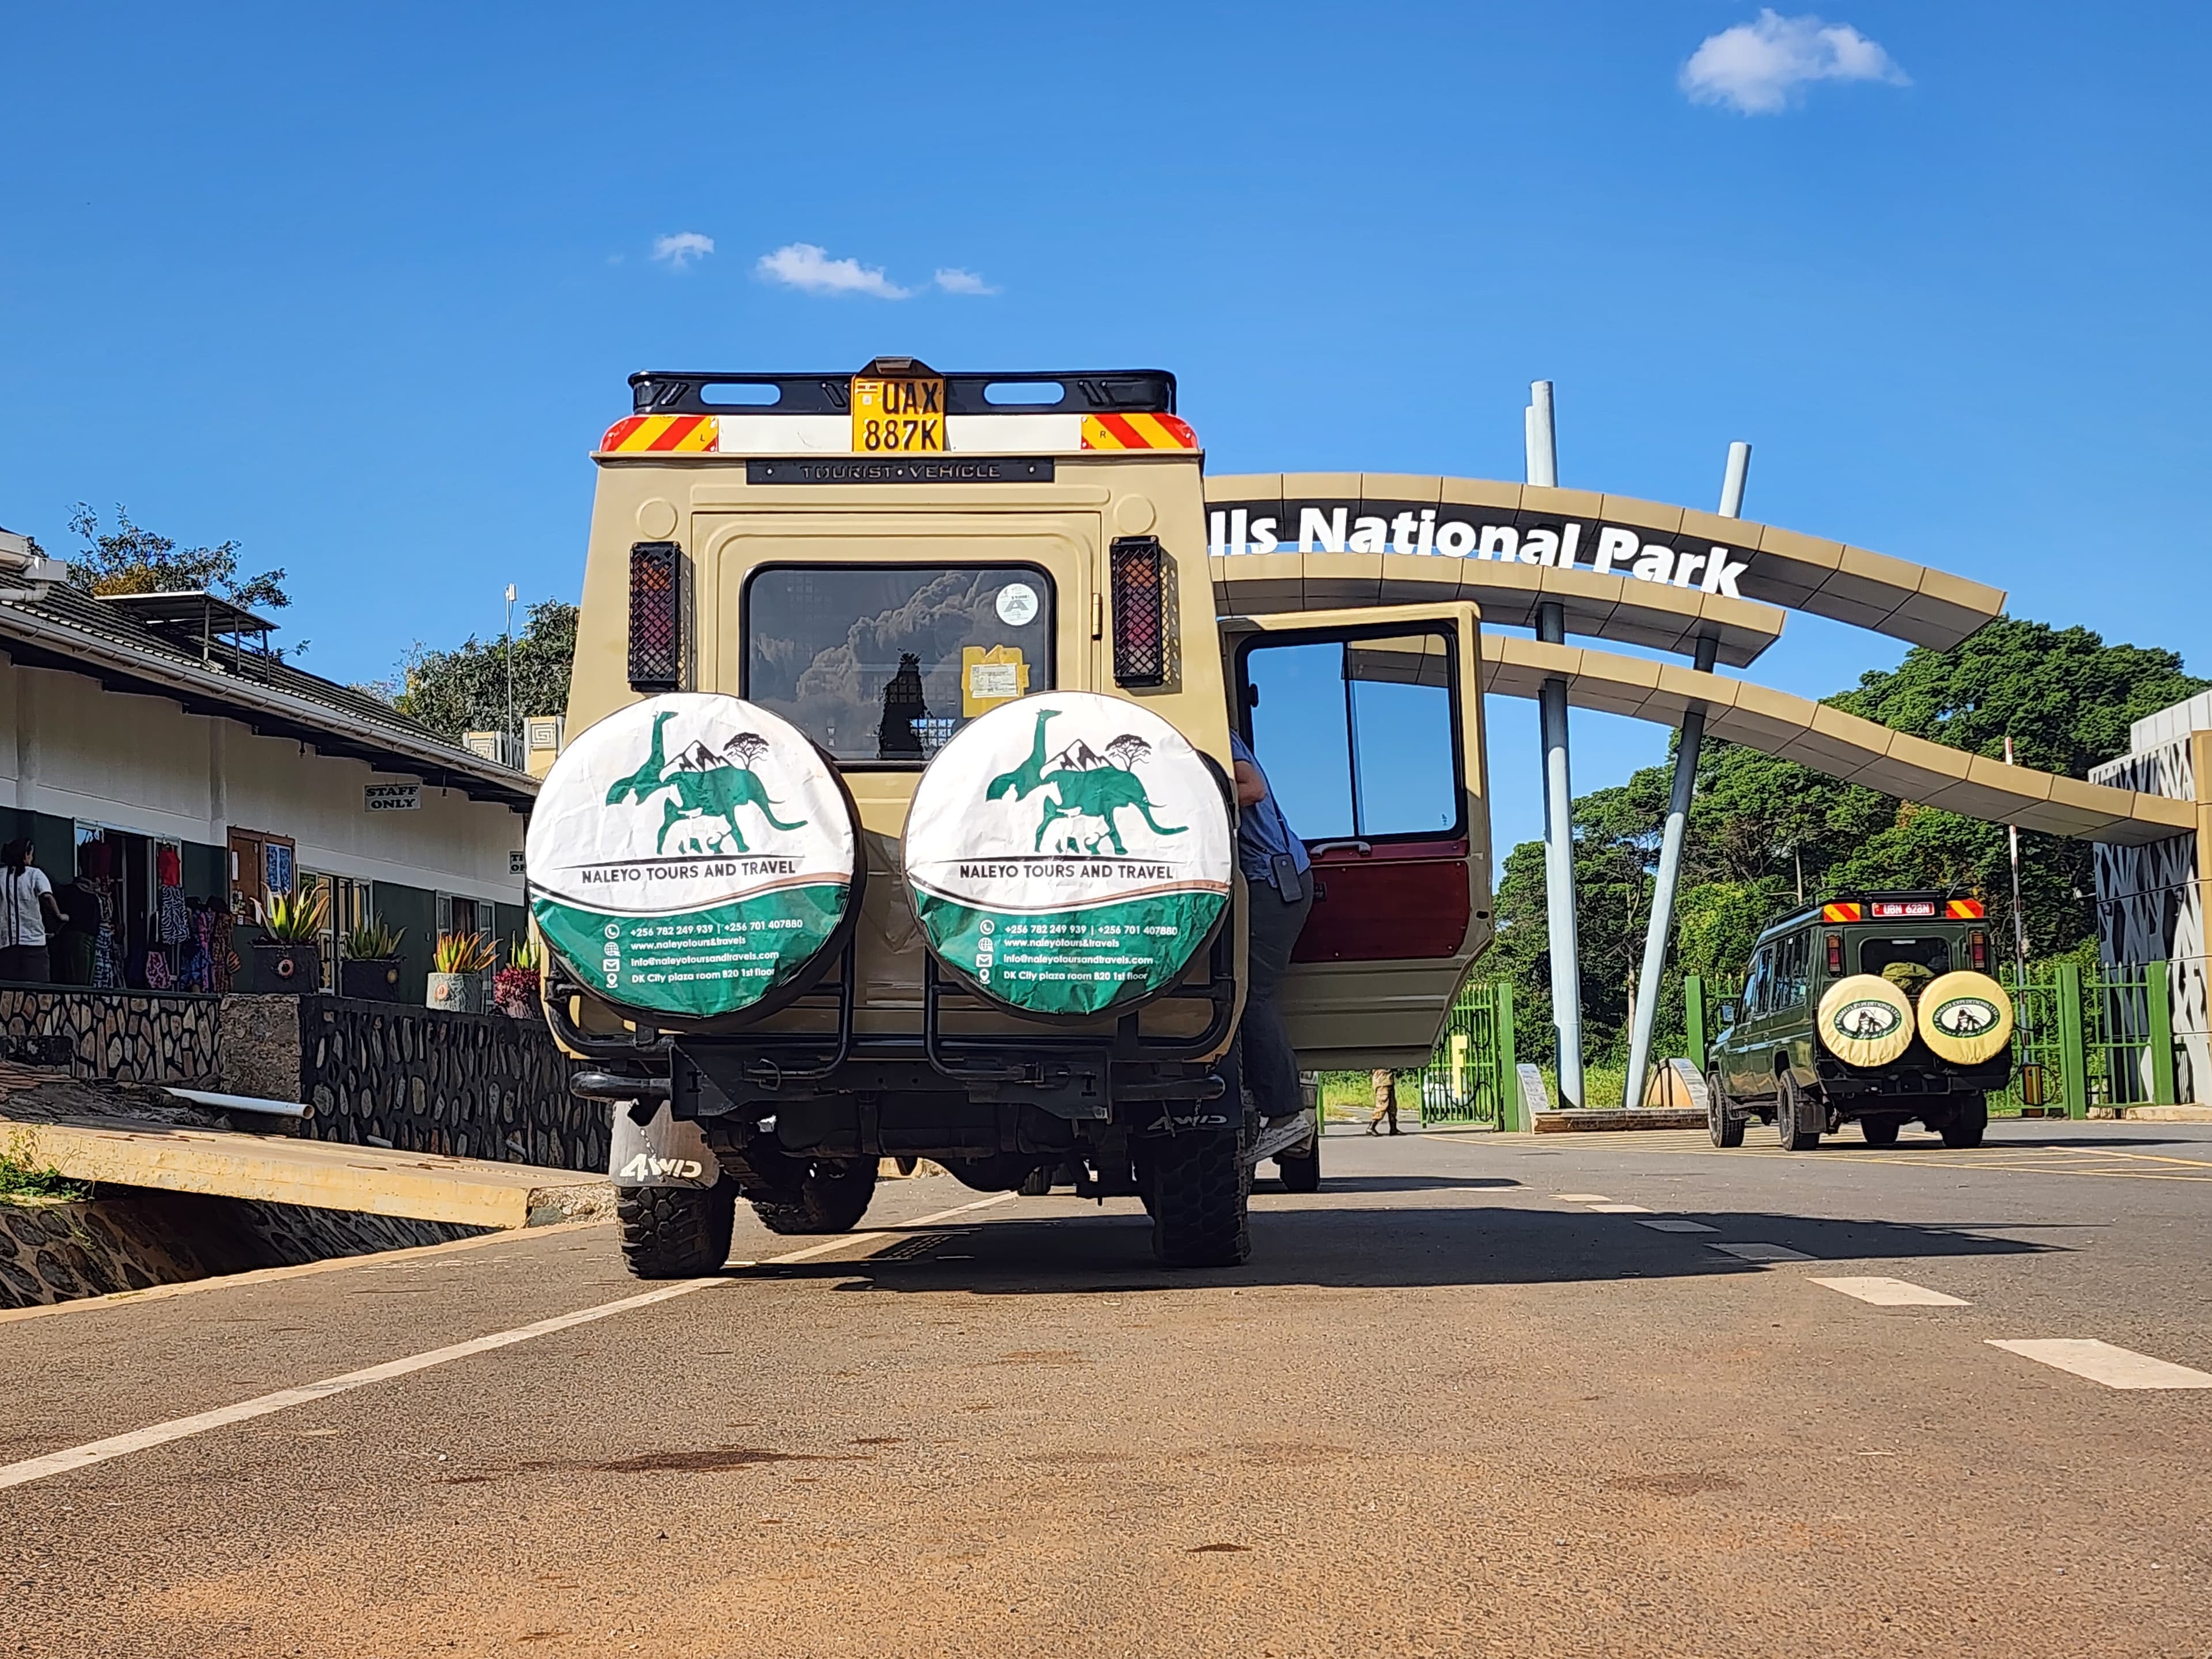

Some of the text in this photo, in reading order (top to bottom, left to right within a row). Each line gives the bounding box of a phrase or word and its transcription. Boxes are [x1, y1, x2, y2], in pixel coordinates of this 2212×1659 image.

[882, 382, 938, 415] UAX
[700, 434, 705, 442] L
[865, 419, 938, 450] 887K
[1100, 430, 1106, 438] R
[800, 465, 1001, 479] TOURIST VEHICLE
[1298, 507, 1581, 569] National
[1593, 527, 1749, 599] Park
[366, 786, 418, 797] STAFF
[371, 798, 416, 809] ONLY
[582, 861, 796, 884] NALEYO TOURS AND TRAVEL
[960, 865, 1173, 880] NALEYO TOURS AND TRAVEL
[1883, 904, 1903, 915] UBN
[630, 927, 654, 937] +256
[656, 926, 674, 935] 782
[676, 925, 694, 935] 249
[696, 924, 714, 934] 939
[724, 922, 747, 931] +256
[749, 921, 766, 930] 701
[1005, 925, 1028, 934] +256
[1031, 925, 1048, 934] 782
[1050, 924, 1067, 934] 249
[1070, 925, 1087, 934] 939
[1098, 925, 1122, 934] +256
[1124, 925, 1141, 934] 701
[1143, 926, 1178, 935] 407880
[631, 974, 645, 983] DK
[647, 974, 666, 983] City
[668, 972, 694, 983] plaza
[696, 972, 721, 980] room
[741, 968, 753, 977] 1st
[755, 968, 775, 976] floor
[1003, 971, 1017, 979] DK
[1018, 971, 1037, 982] City
[1039, 971, 1066, 982] plaza
[1113, 972, 1125, 980] 1st
[1127, 971, 1148, 980] floor
[1147, 1115, 1227, 1130] 4WD
[620, 1153, 702, 1181] 4WD
